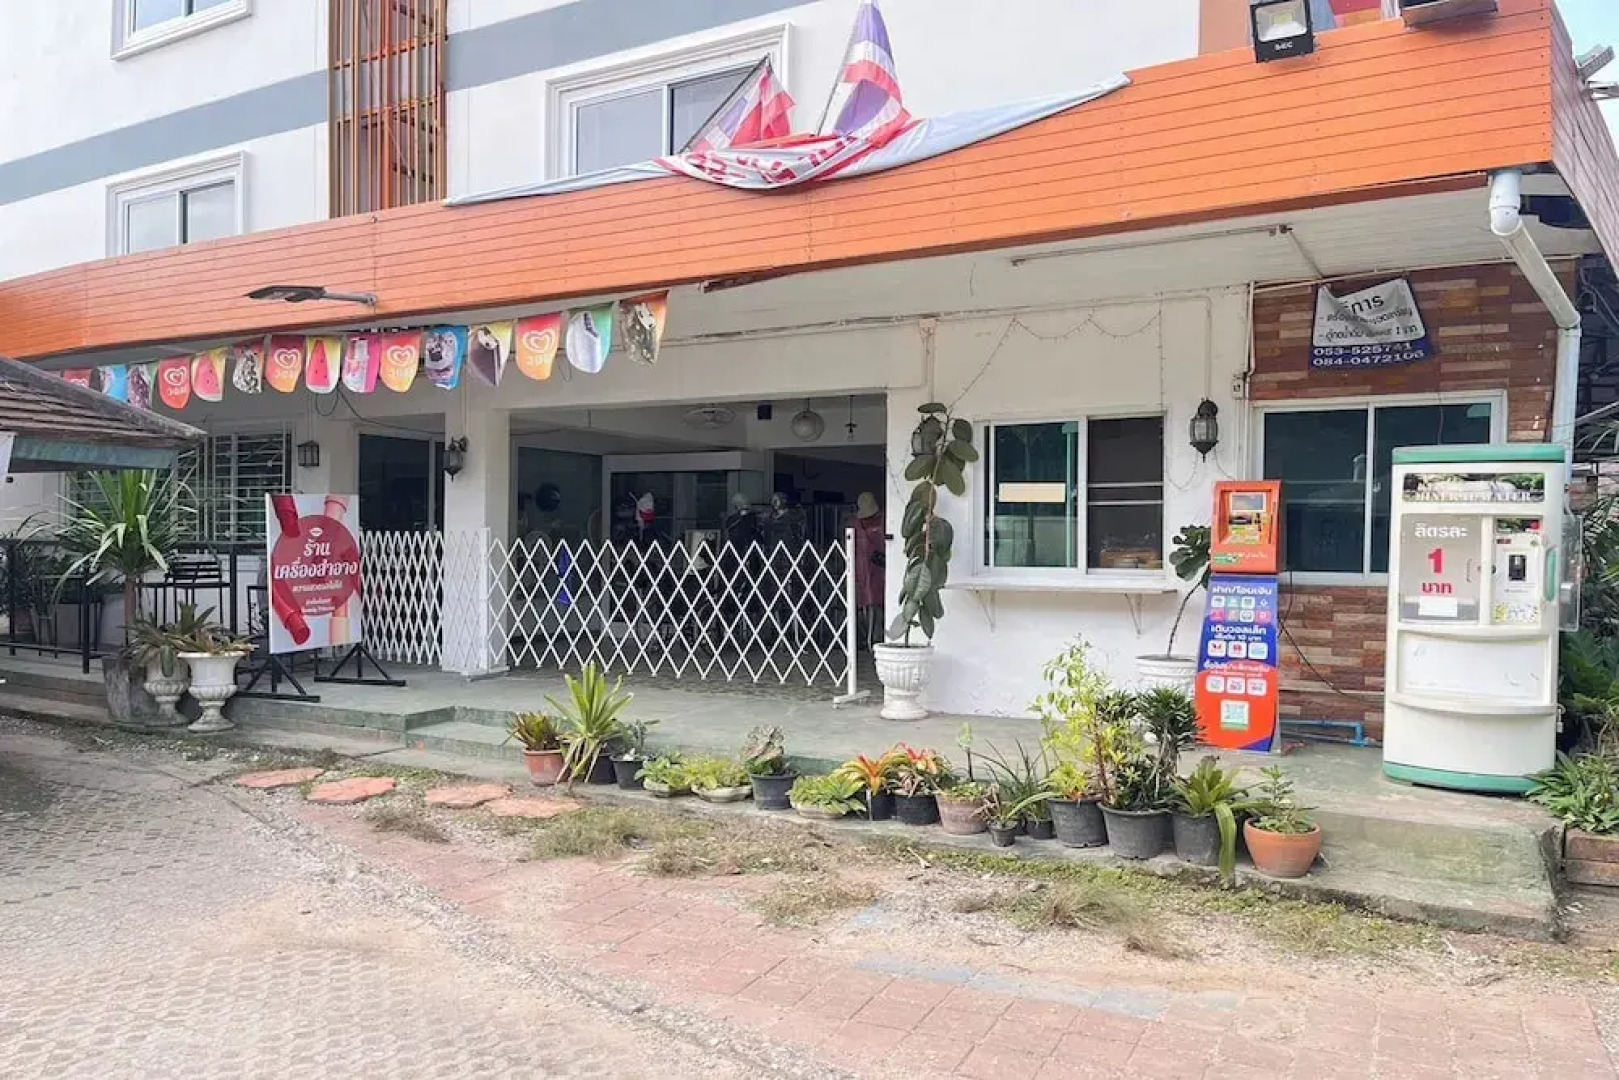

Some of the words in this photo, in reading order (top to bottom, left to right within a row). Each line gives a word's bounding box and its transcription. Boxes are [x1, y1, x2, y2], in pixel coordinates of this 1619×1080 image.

[1414, 522, 1468, 539] ลิตรละ
[303, 538, 331, 557] ร้าน
[274, 557, 358, 579] เครื่องสำอาง
[1428, 548, 1445, 574] 1
[1422, 582, 1452, 595] บาท
